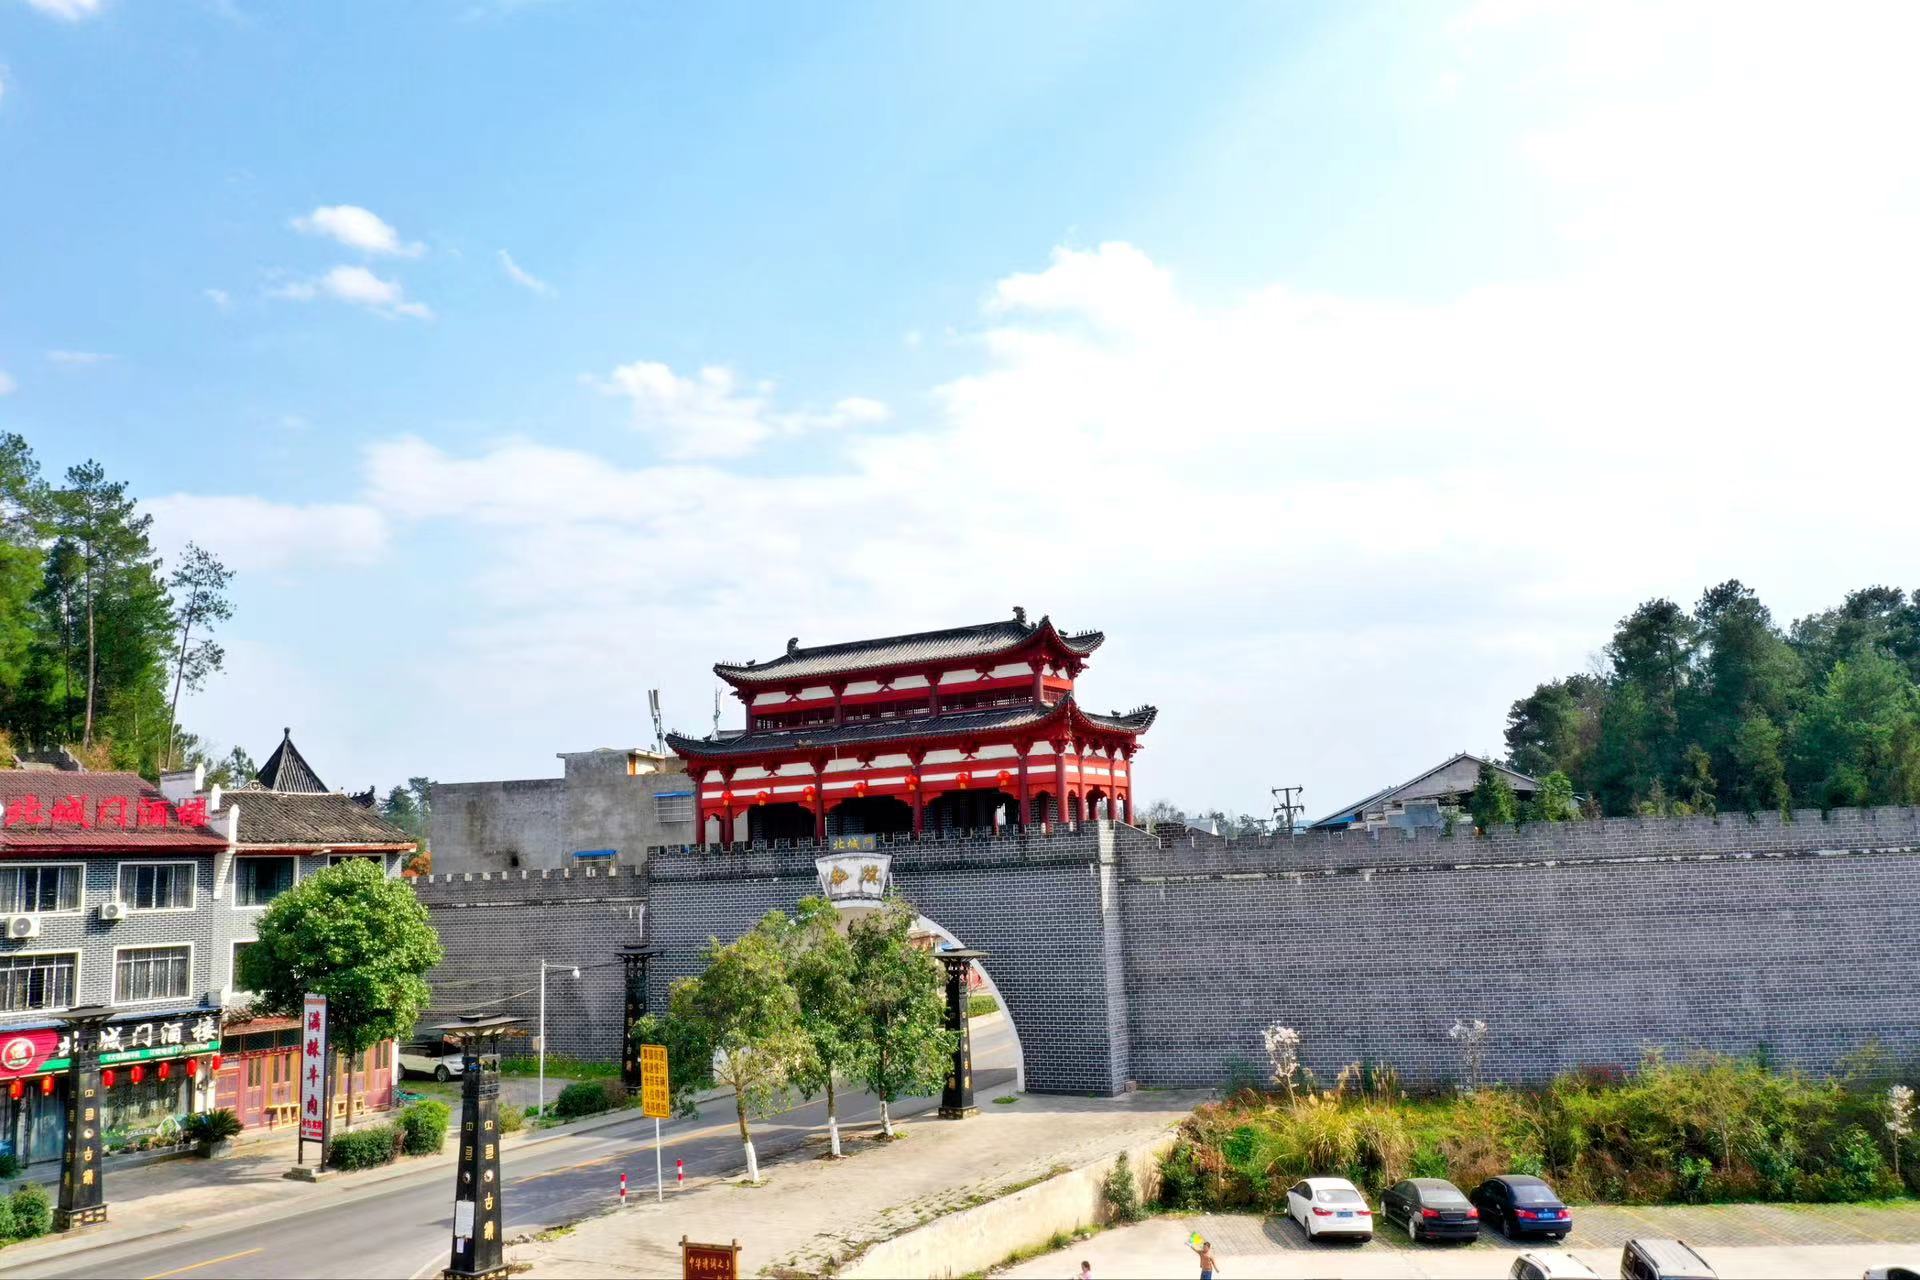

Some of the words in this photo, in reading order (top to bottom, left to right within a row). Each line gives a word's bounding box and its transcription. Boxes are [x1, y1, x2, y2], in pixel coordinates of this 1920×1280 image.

[5, 794, 211, 829] 北城门酒楼
[58, 1016, 218, 1058] 北城门酒楼
